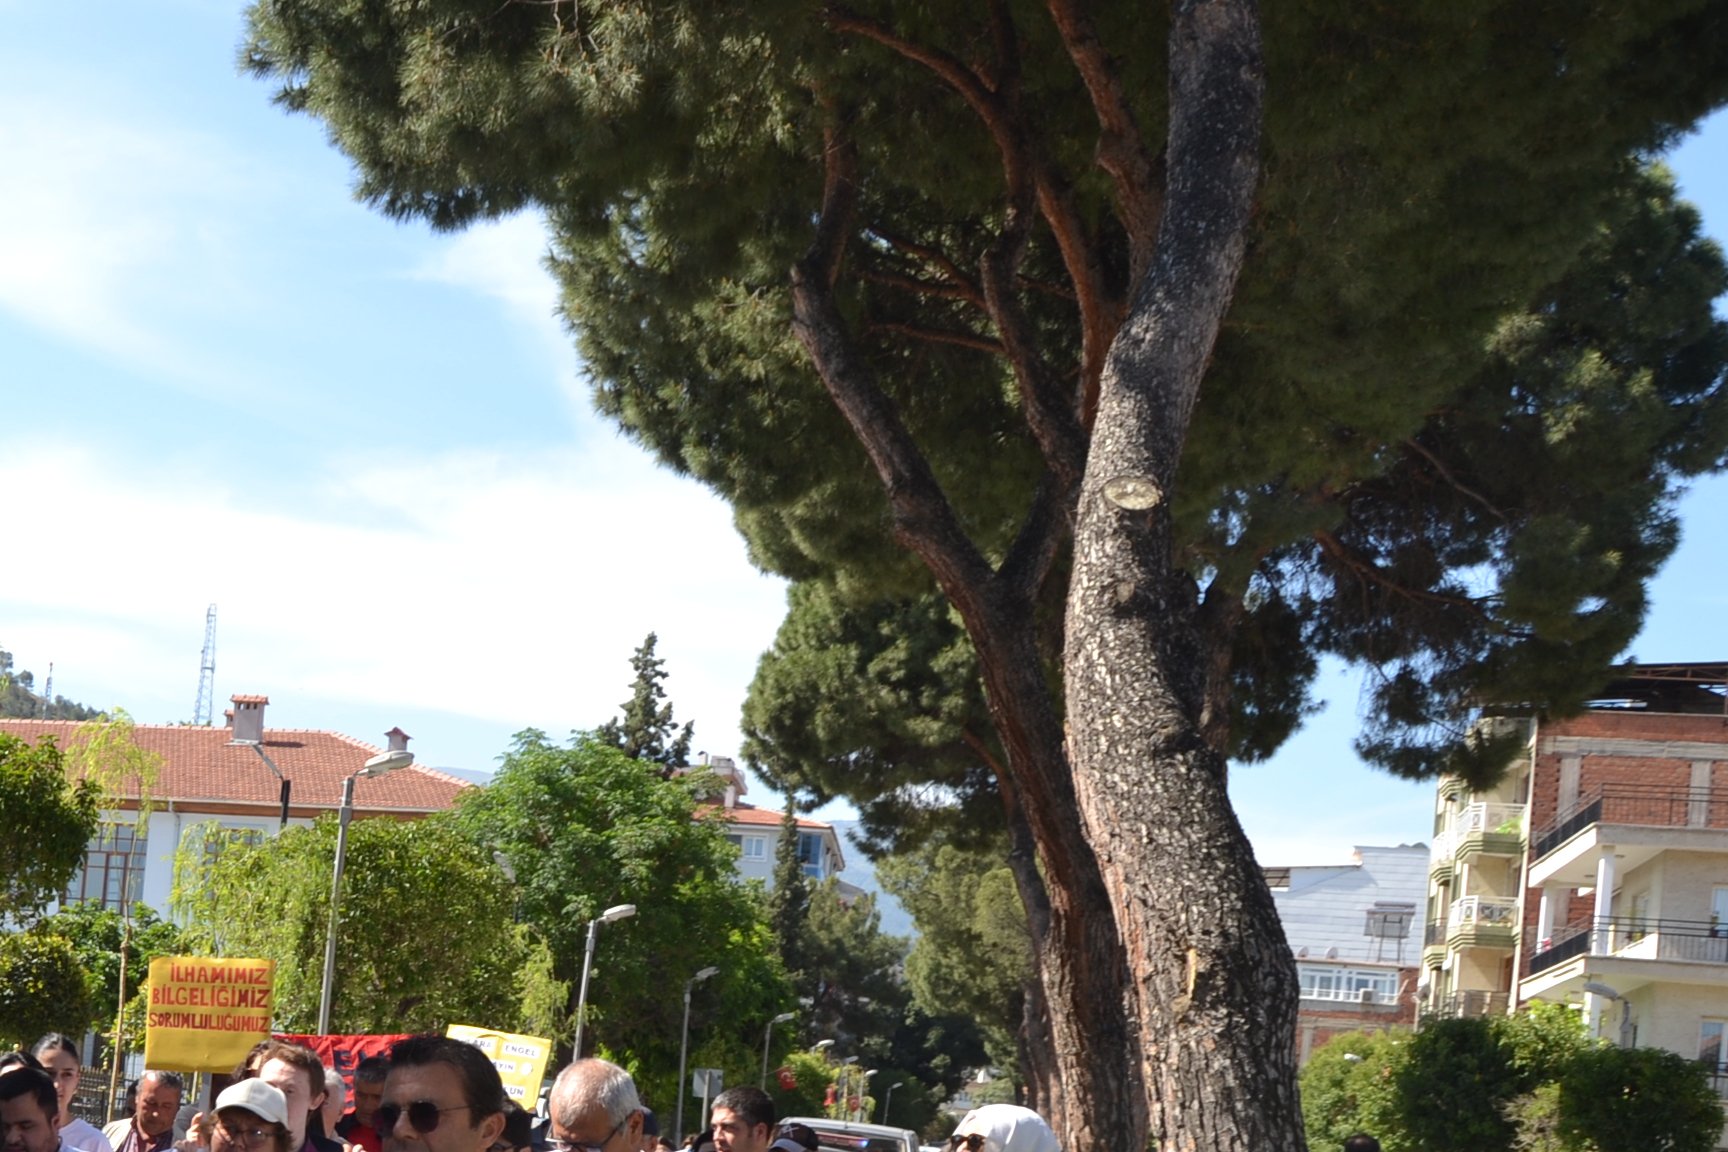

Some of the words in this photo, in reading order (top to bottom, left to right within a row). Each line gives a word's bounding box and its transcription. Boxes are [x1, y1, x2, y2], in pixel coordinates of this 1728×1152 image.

[170, 962, 268, 985] İLHAMIMIZ
[152, 984, 270, 1008] BİLGELİĞİMİZ
[148, 1011, 269, 1033] SORUMLULUĞUMUZ
[505, 1044, 537, 1057] ENGEL
